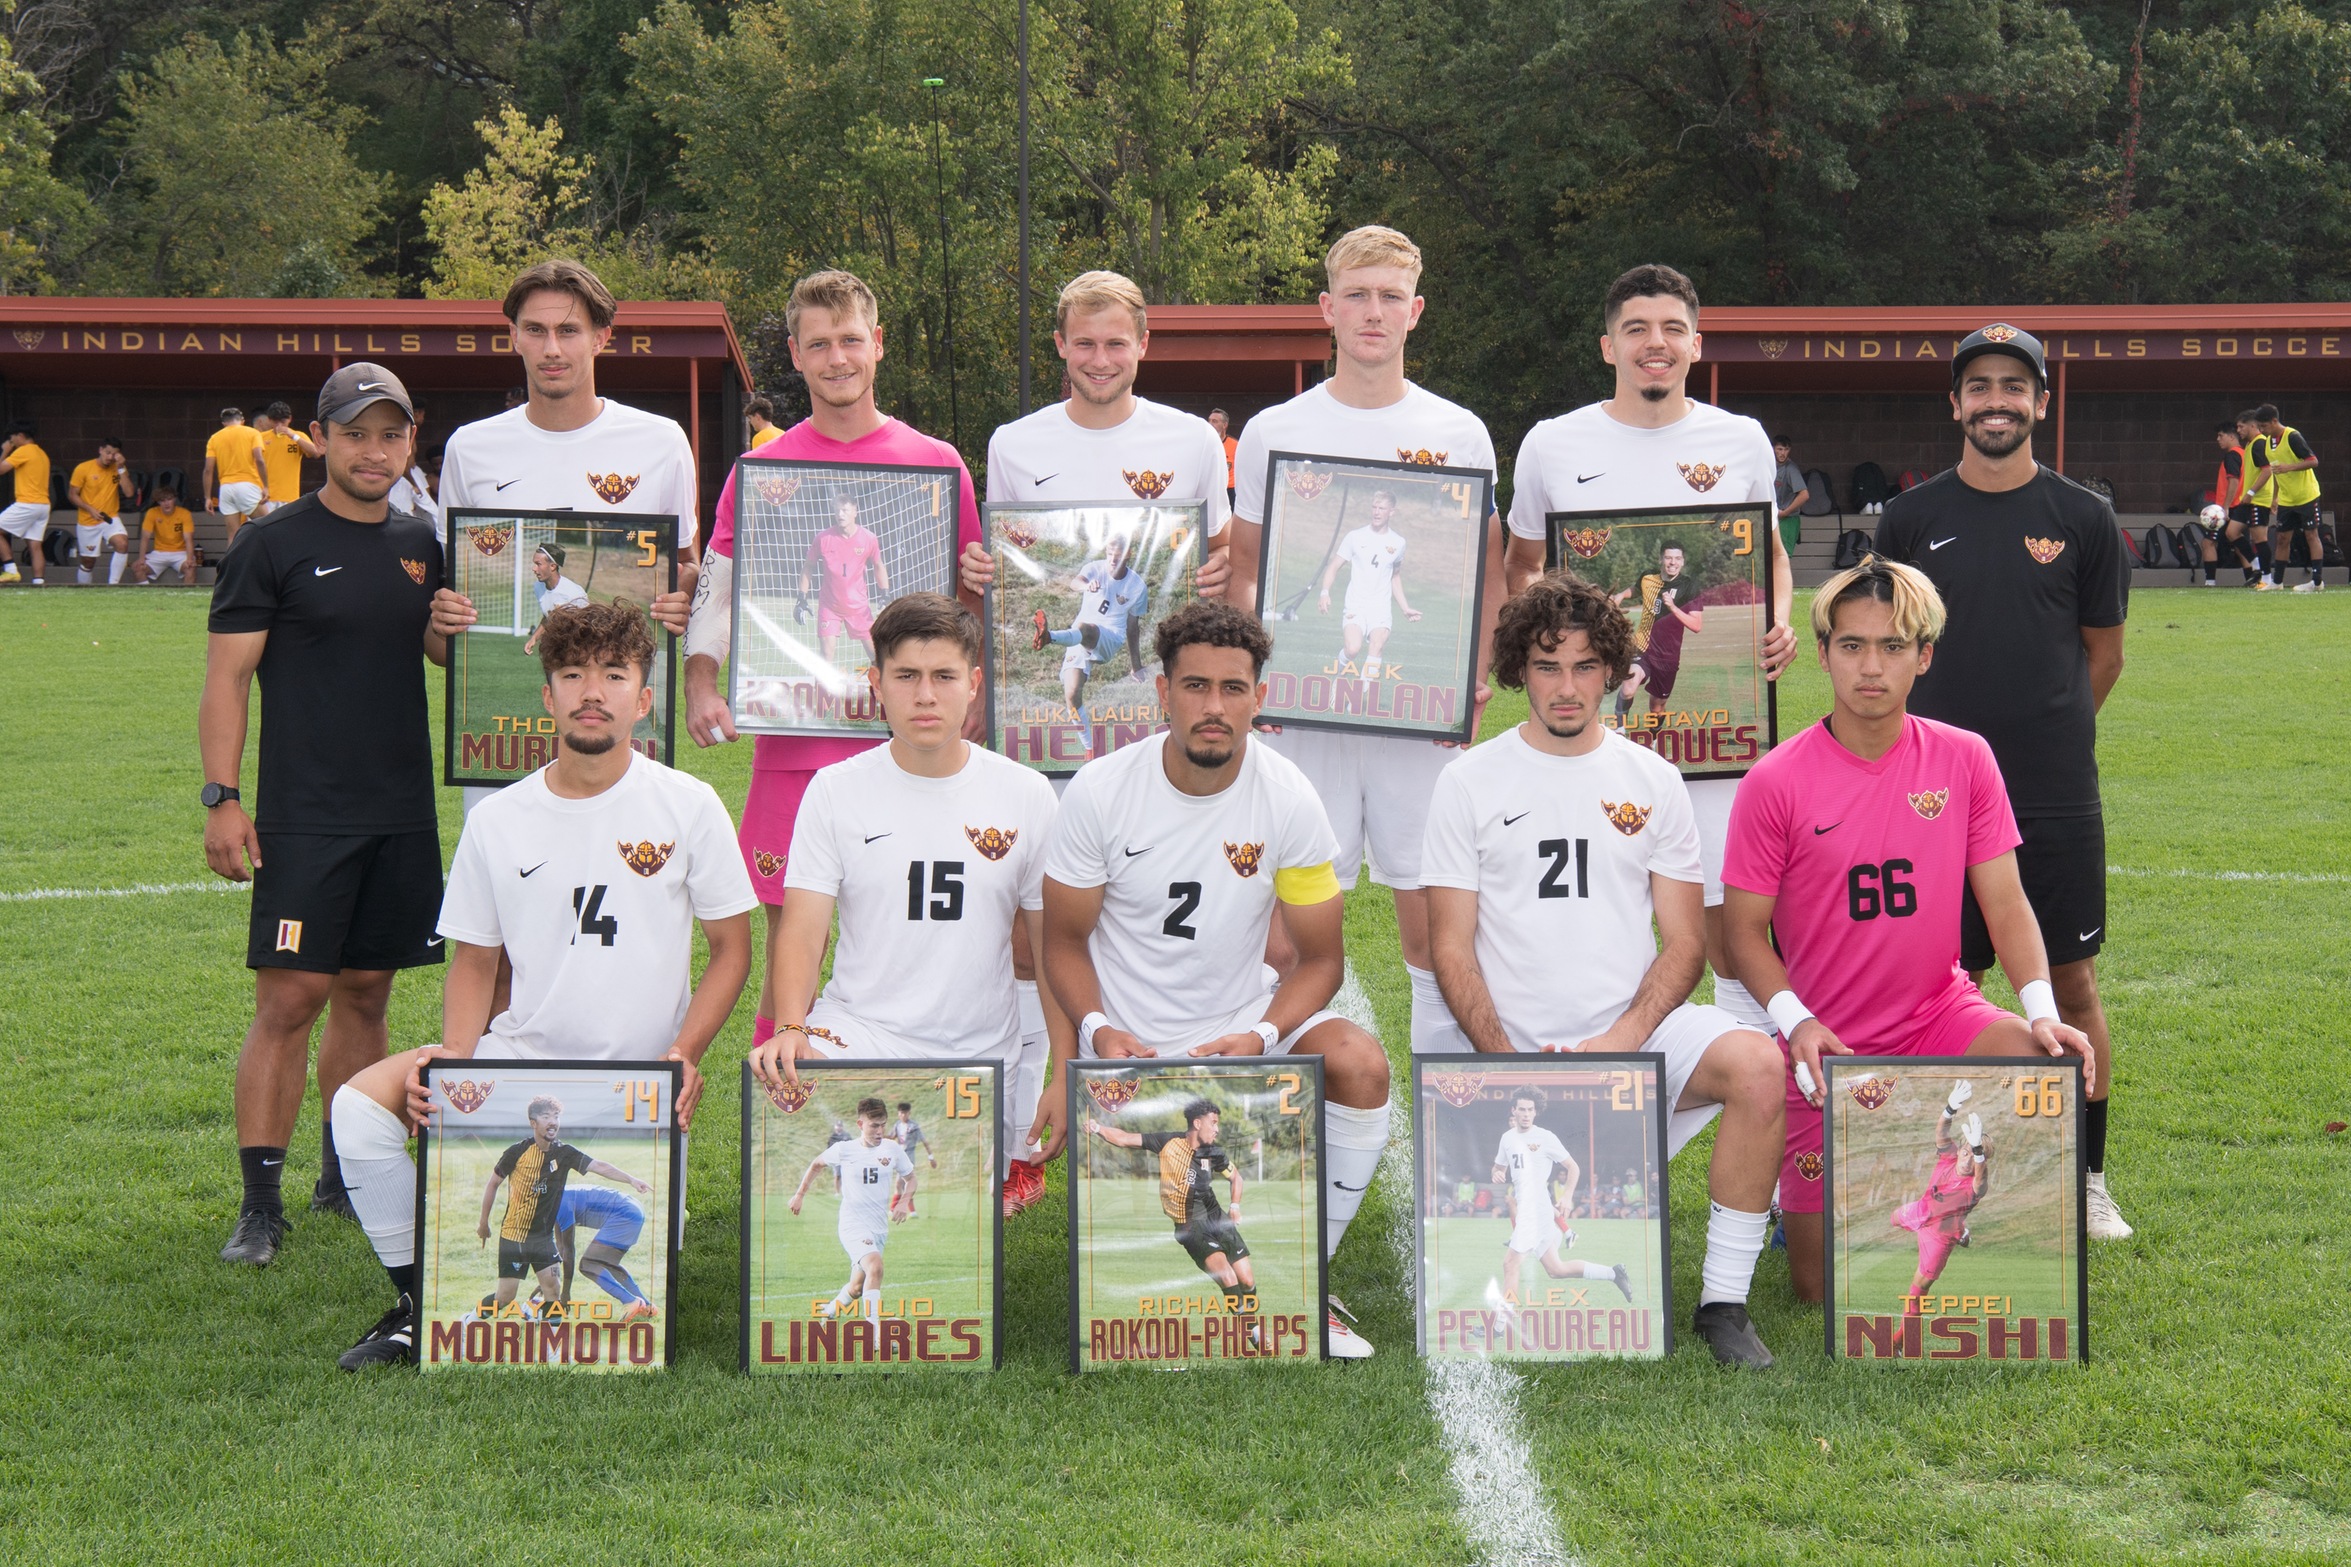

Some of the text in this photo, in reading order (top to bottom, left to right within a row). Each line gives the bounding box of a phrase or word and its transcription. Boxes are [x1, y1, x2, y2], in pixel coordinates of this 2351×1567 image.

[62, 331, 653, 354] INDIAN HILLS SOER
[1804, 339, 1959, 358] INDIA
[2043, 338, 2147, 358] ILLS
[1440, 482, 1471, 520] #4
[626, 530, 657, 568] #5
[1719, 518, 1753, 556] #9
[1324, 659, 1403, 681] JACK
[1022, 706, 1082, 723] LUKA
[1265, 671, 1457, 725] DONLAN
[492, 716, 557, 734] THO
[1602, 709, 1729, 730] GUSTAVO
[1003, 723, 1170, 763] HEIN
[1538, 837, 1589, 899] 21
[906, 860, 965, 921] 15
[1848, 858, 1918, 922] 66
[570, 884, 618, 947] 14
[1162, 881, 1202, 941] 2
[612, 1079, 660, 1122] #14
[933, 1076, 981, 1119] #15
[1265, 1073, 1301, 1115] #2
[1598, 1070, 1644, 1112] #21
[2000, 1075, 2063, 1118] #66
[862, 1167, 879, 1185] 15
[476, 1299, 612, 1319] HAYATO
[810, 1297, 934, 1318] EMILIO
[1139, 1294, 1260, 1315] RICHARD
[1504, 1287, 1590, 1307] ALEX
[1898, 1295, 2012, 1314] TEPPEI
[429, 1319, 655, 1366] MORIMOTO
[759, 1318, 982, 1364] LINARES
[1089, 1313, 1309, 1362] ROKODI-PHELPS
[1437, 1308, 1651, 1353] PEYTOUREAU
[1845, 1315, 2068, 1361] NISHI
